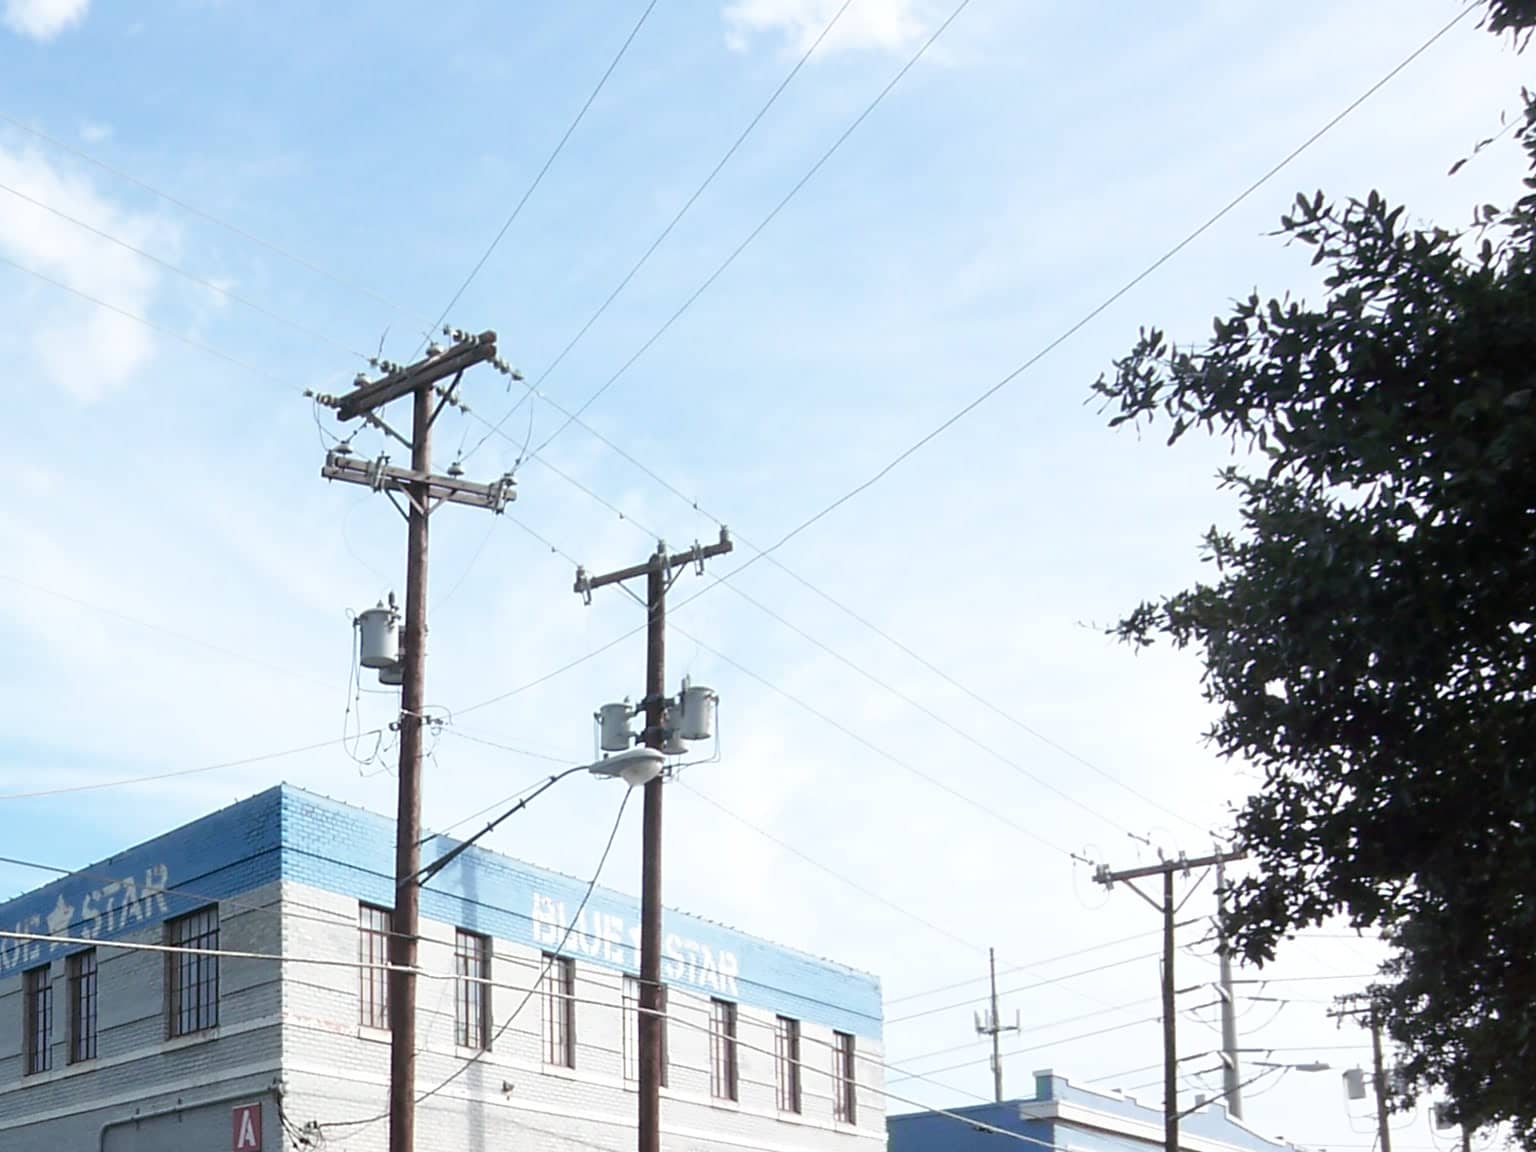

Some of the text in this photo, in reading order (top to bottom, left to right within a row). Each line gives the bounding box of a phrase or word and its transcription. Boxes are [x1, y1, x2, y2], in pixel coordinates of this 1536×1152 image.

[80, 863, 169, 939] STAR
[531, 891, 739, 996] BLUE STAR
[237, 1109, 257, 1149] A
